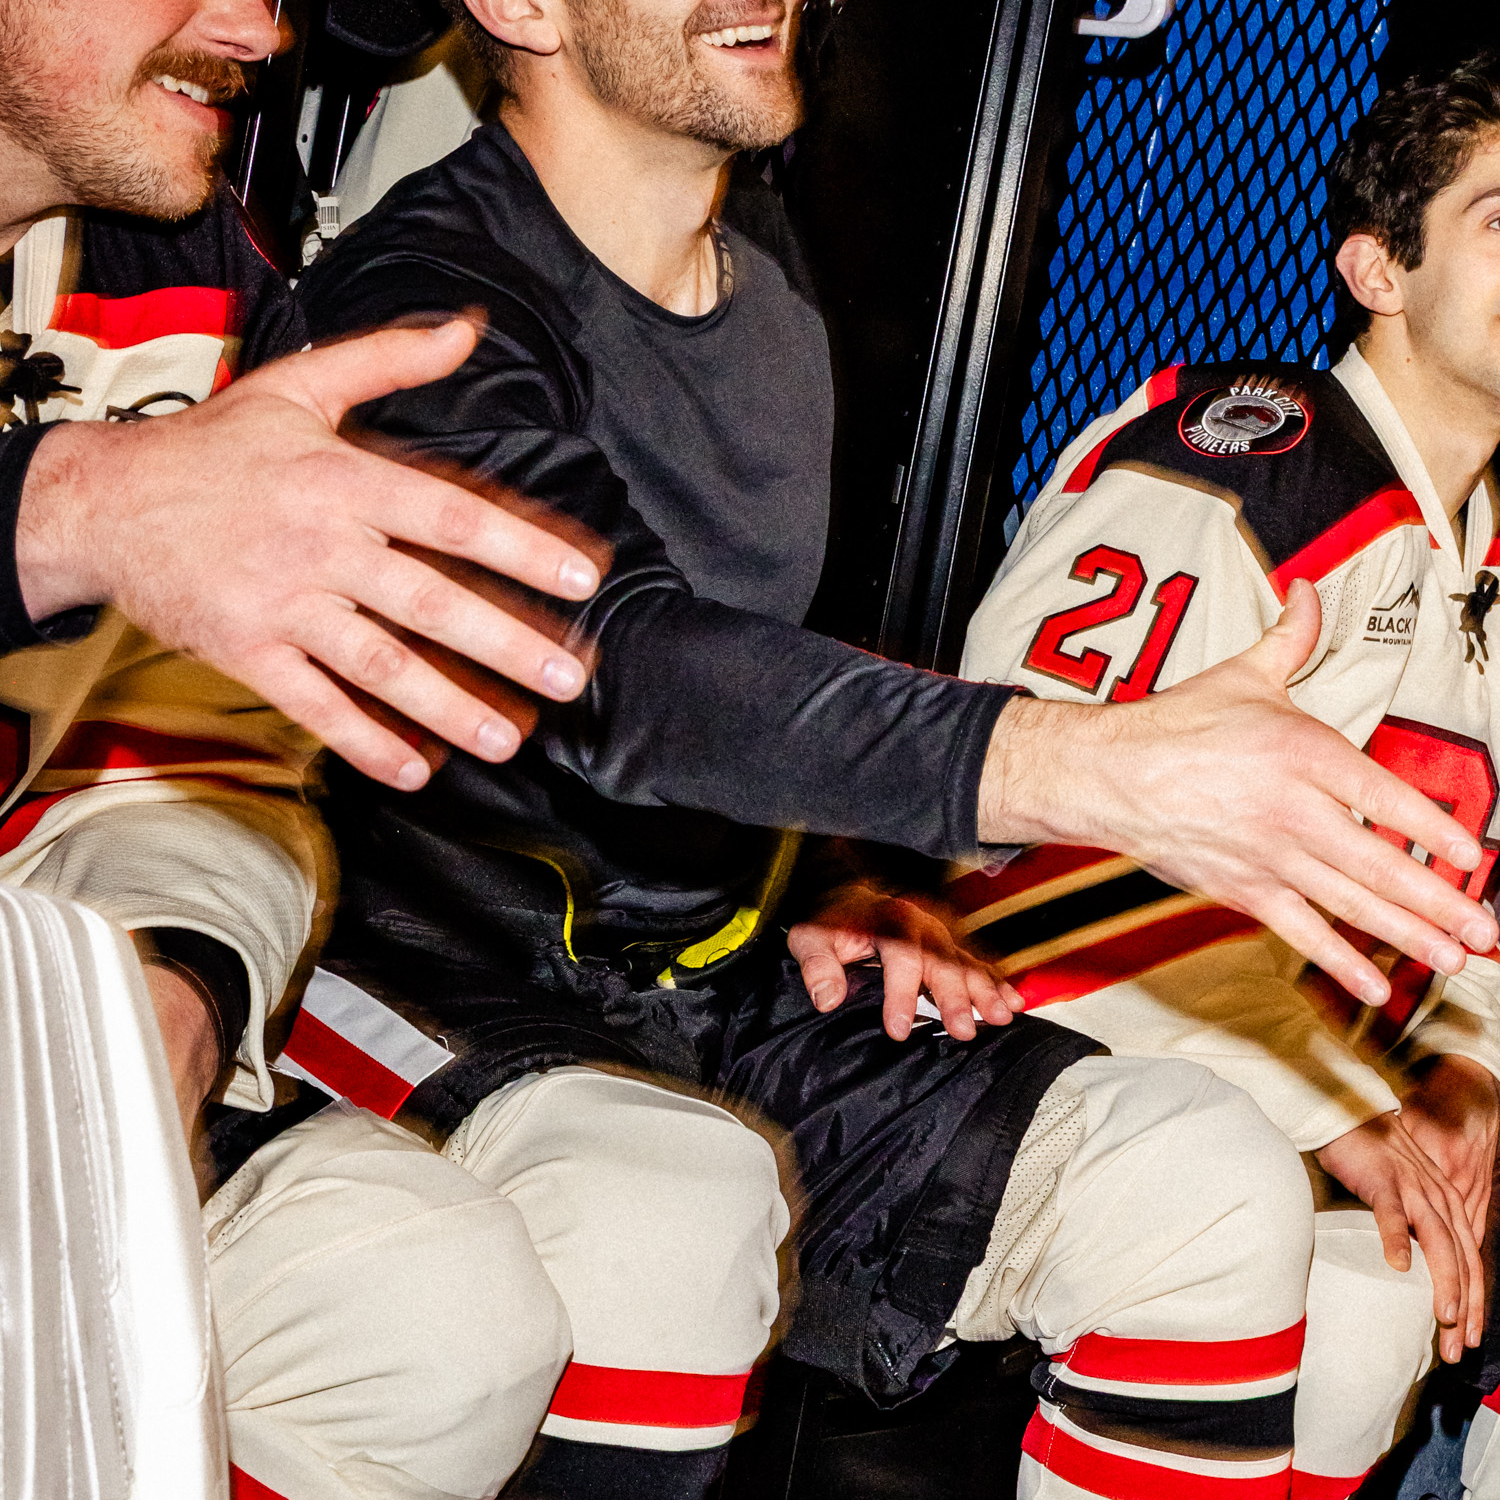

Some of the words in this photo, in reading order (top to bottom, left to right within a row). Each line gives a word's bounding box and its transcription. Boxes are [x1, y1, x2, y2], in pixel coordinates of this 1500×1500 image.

[1229, 385, 1278, 399] PARK
[1273, 396, 1304, 418] CITY
[1184, 423, 1251, 455] PIONEERS
[1021, 543, 1200, 704] 21
[1366, 616, 1411, 634] BLACK
